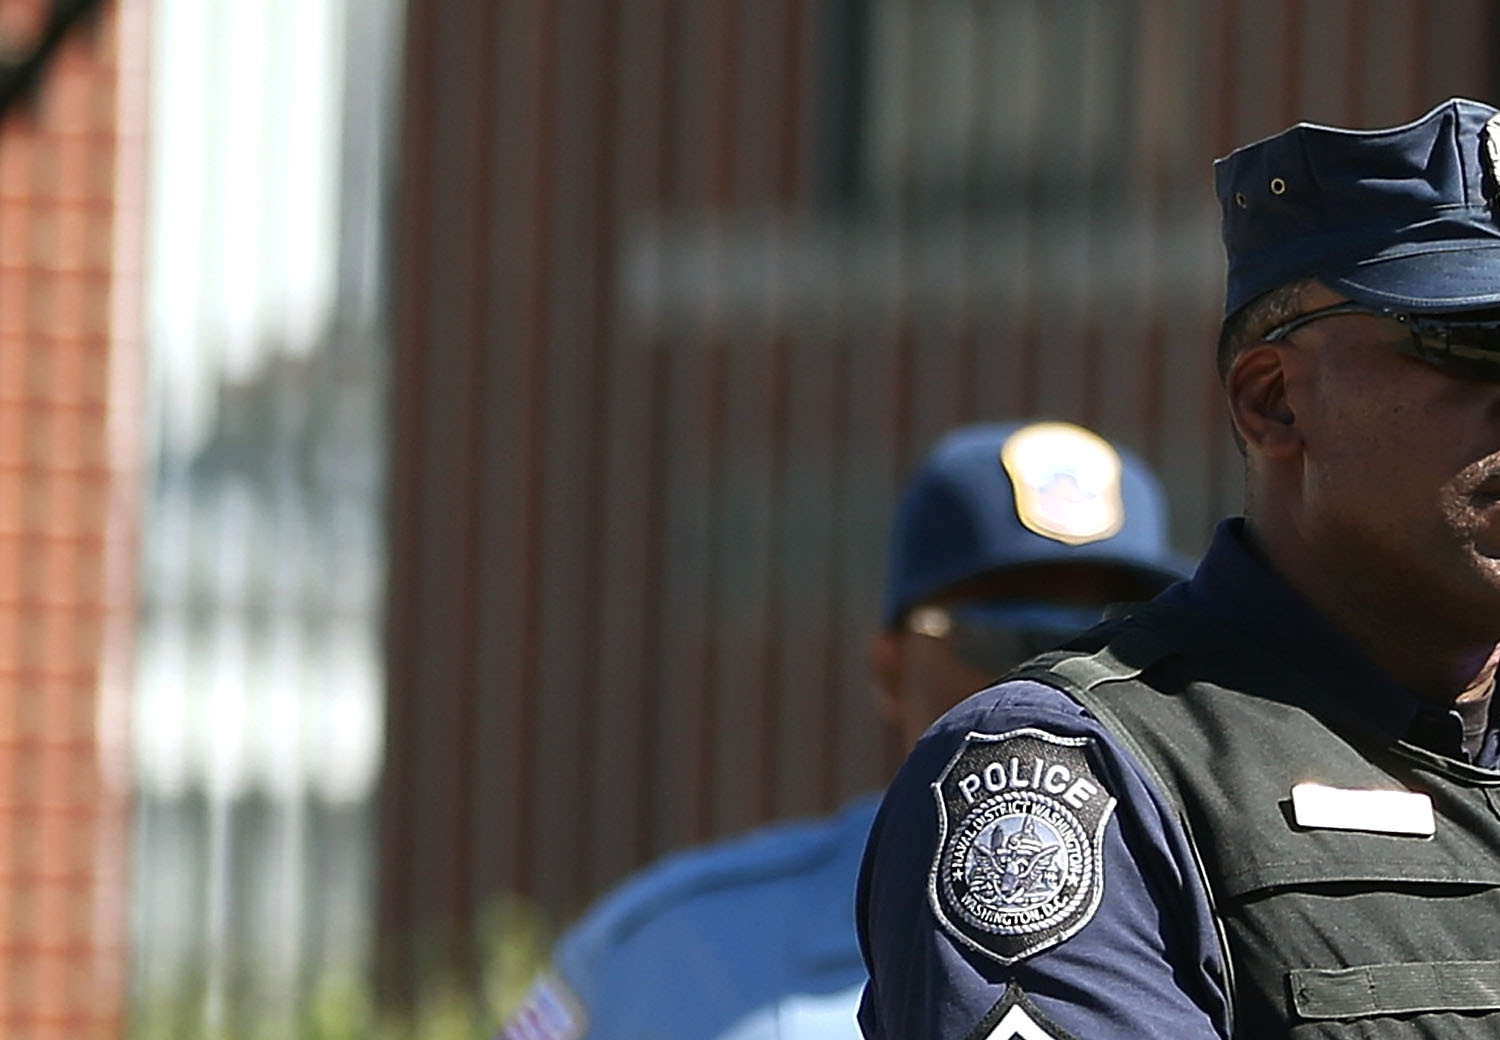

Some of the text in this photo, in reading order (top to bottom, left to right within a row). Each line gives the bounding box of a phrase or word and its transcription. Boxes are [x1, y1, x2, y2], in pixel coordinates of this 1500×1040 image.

[958, 757, 1097, 809] POLICE
[952, 801, 1083, 873] NAVAL DISTRICT WASHINGTON
